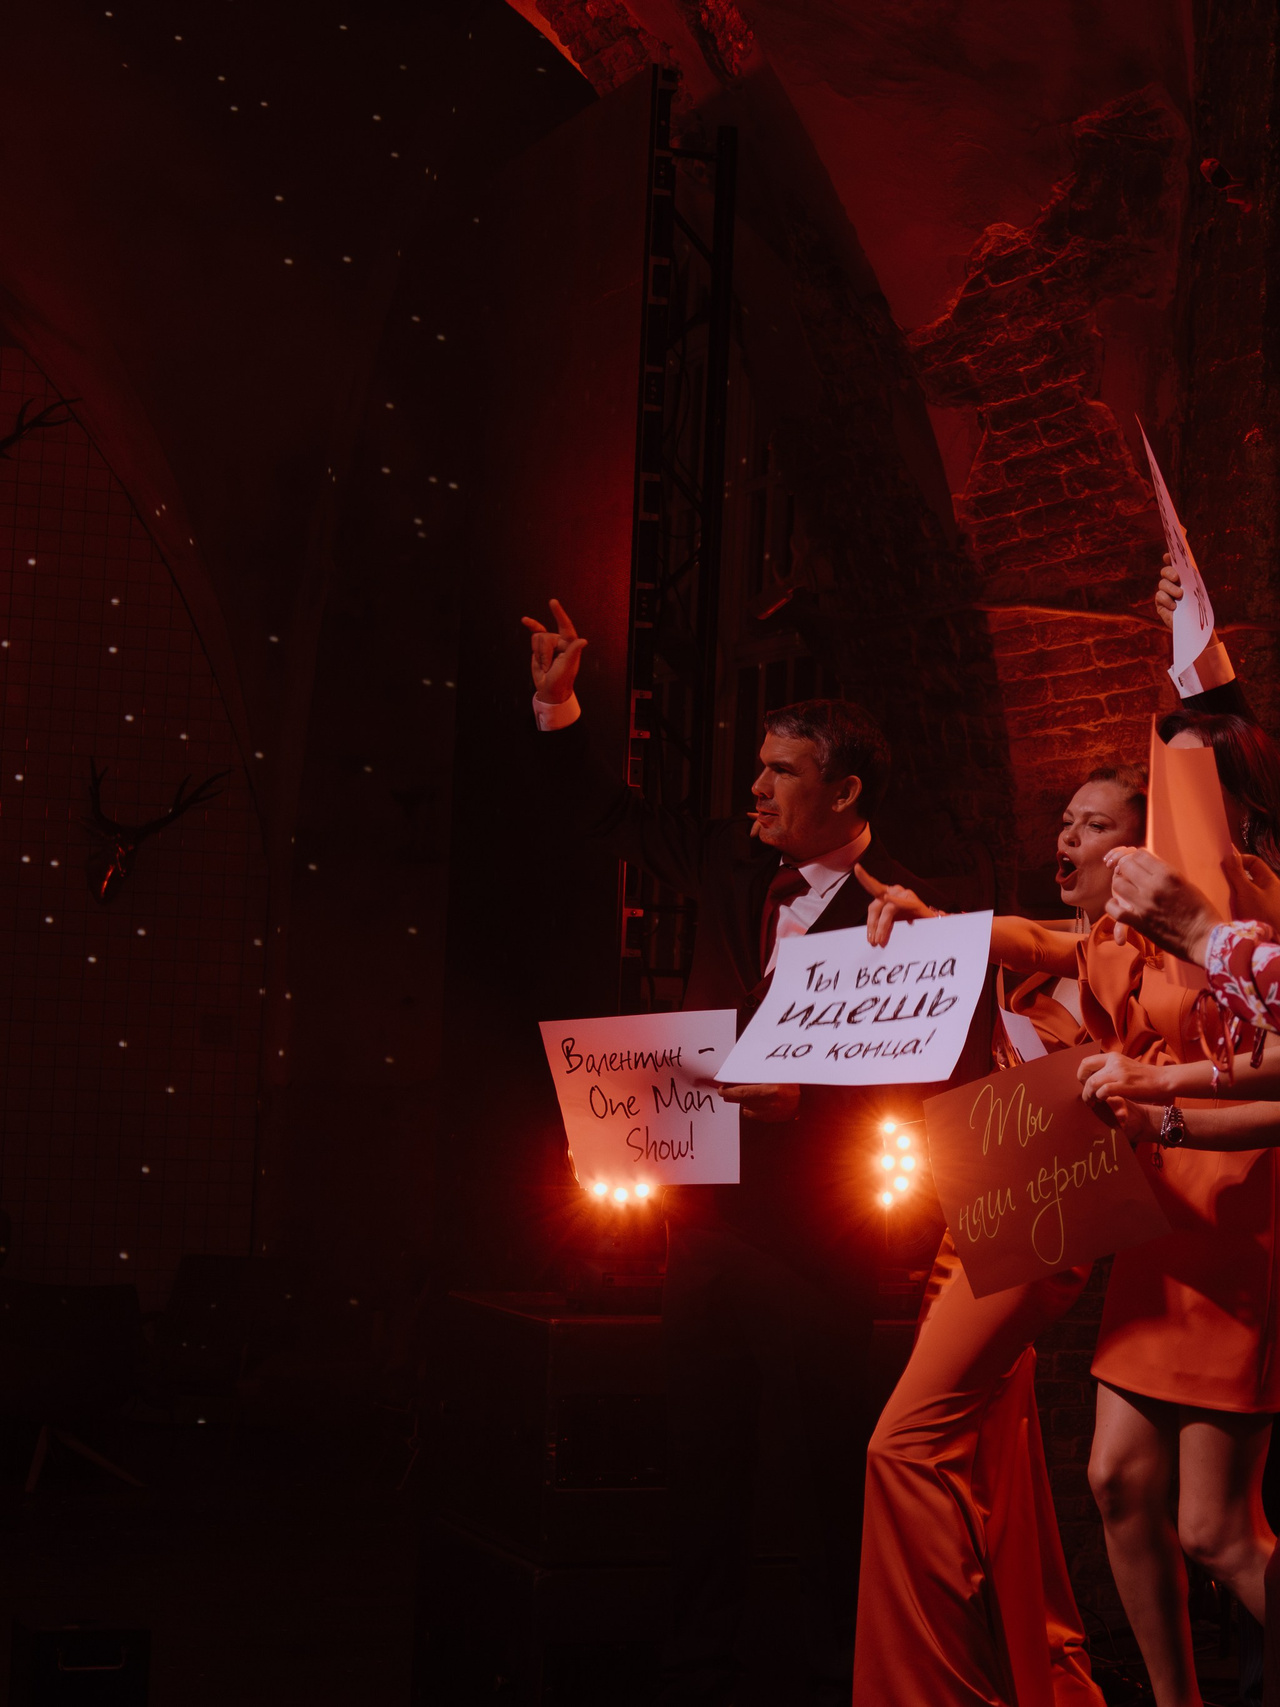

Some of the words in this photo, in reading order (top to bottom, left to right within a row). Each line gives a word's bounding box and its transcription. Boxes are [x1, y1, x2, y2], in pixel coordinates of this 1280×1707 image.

[806, 960, 840, 993] Ты
[855, 957, 958, 990] всегда
[777, 987, 959, 1031] идешь
[561, 1036, 682, 1077] Валентин
[764, 1043, 814, 1061] до
[825, 1028, 937, 1062] конца!
[589, 1084, 641, 1120] One
[652, 1077, 716, 1114] Man
[626, 1120, 695, 1162] Show!
[1026, 1128, 1120, 1265] герой!
